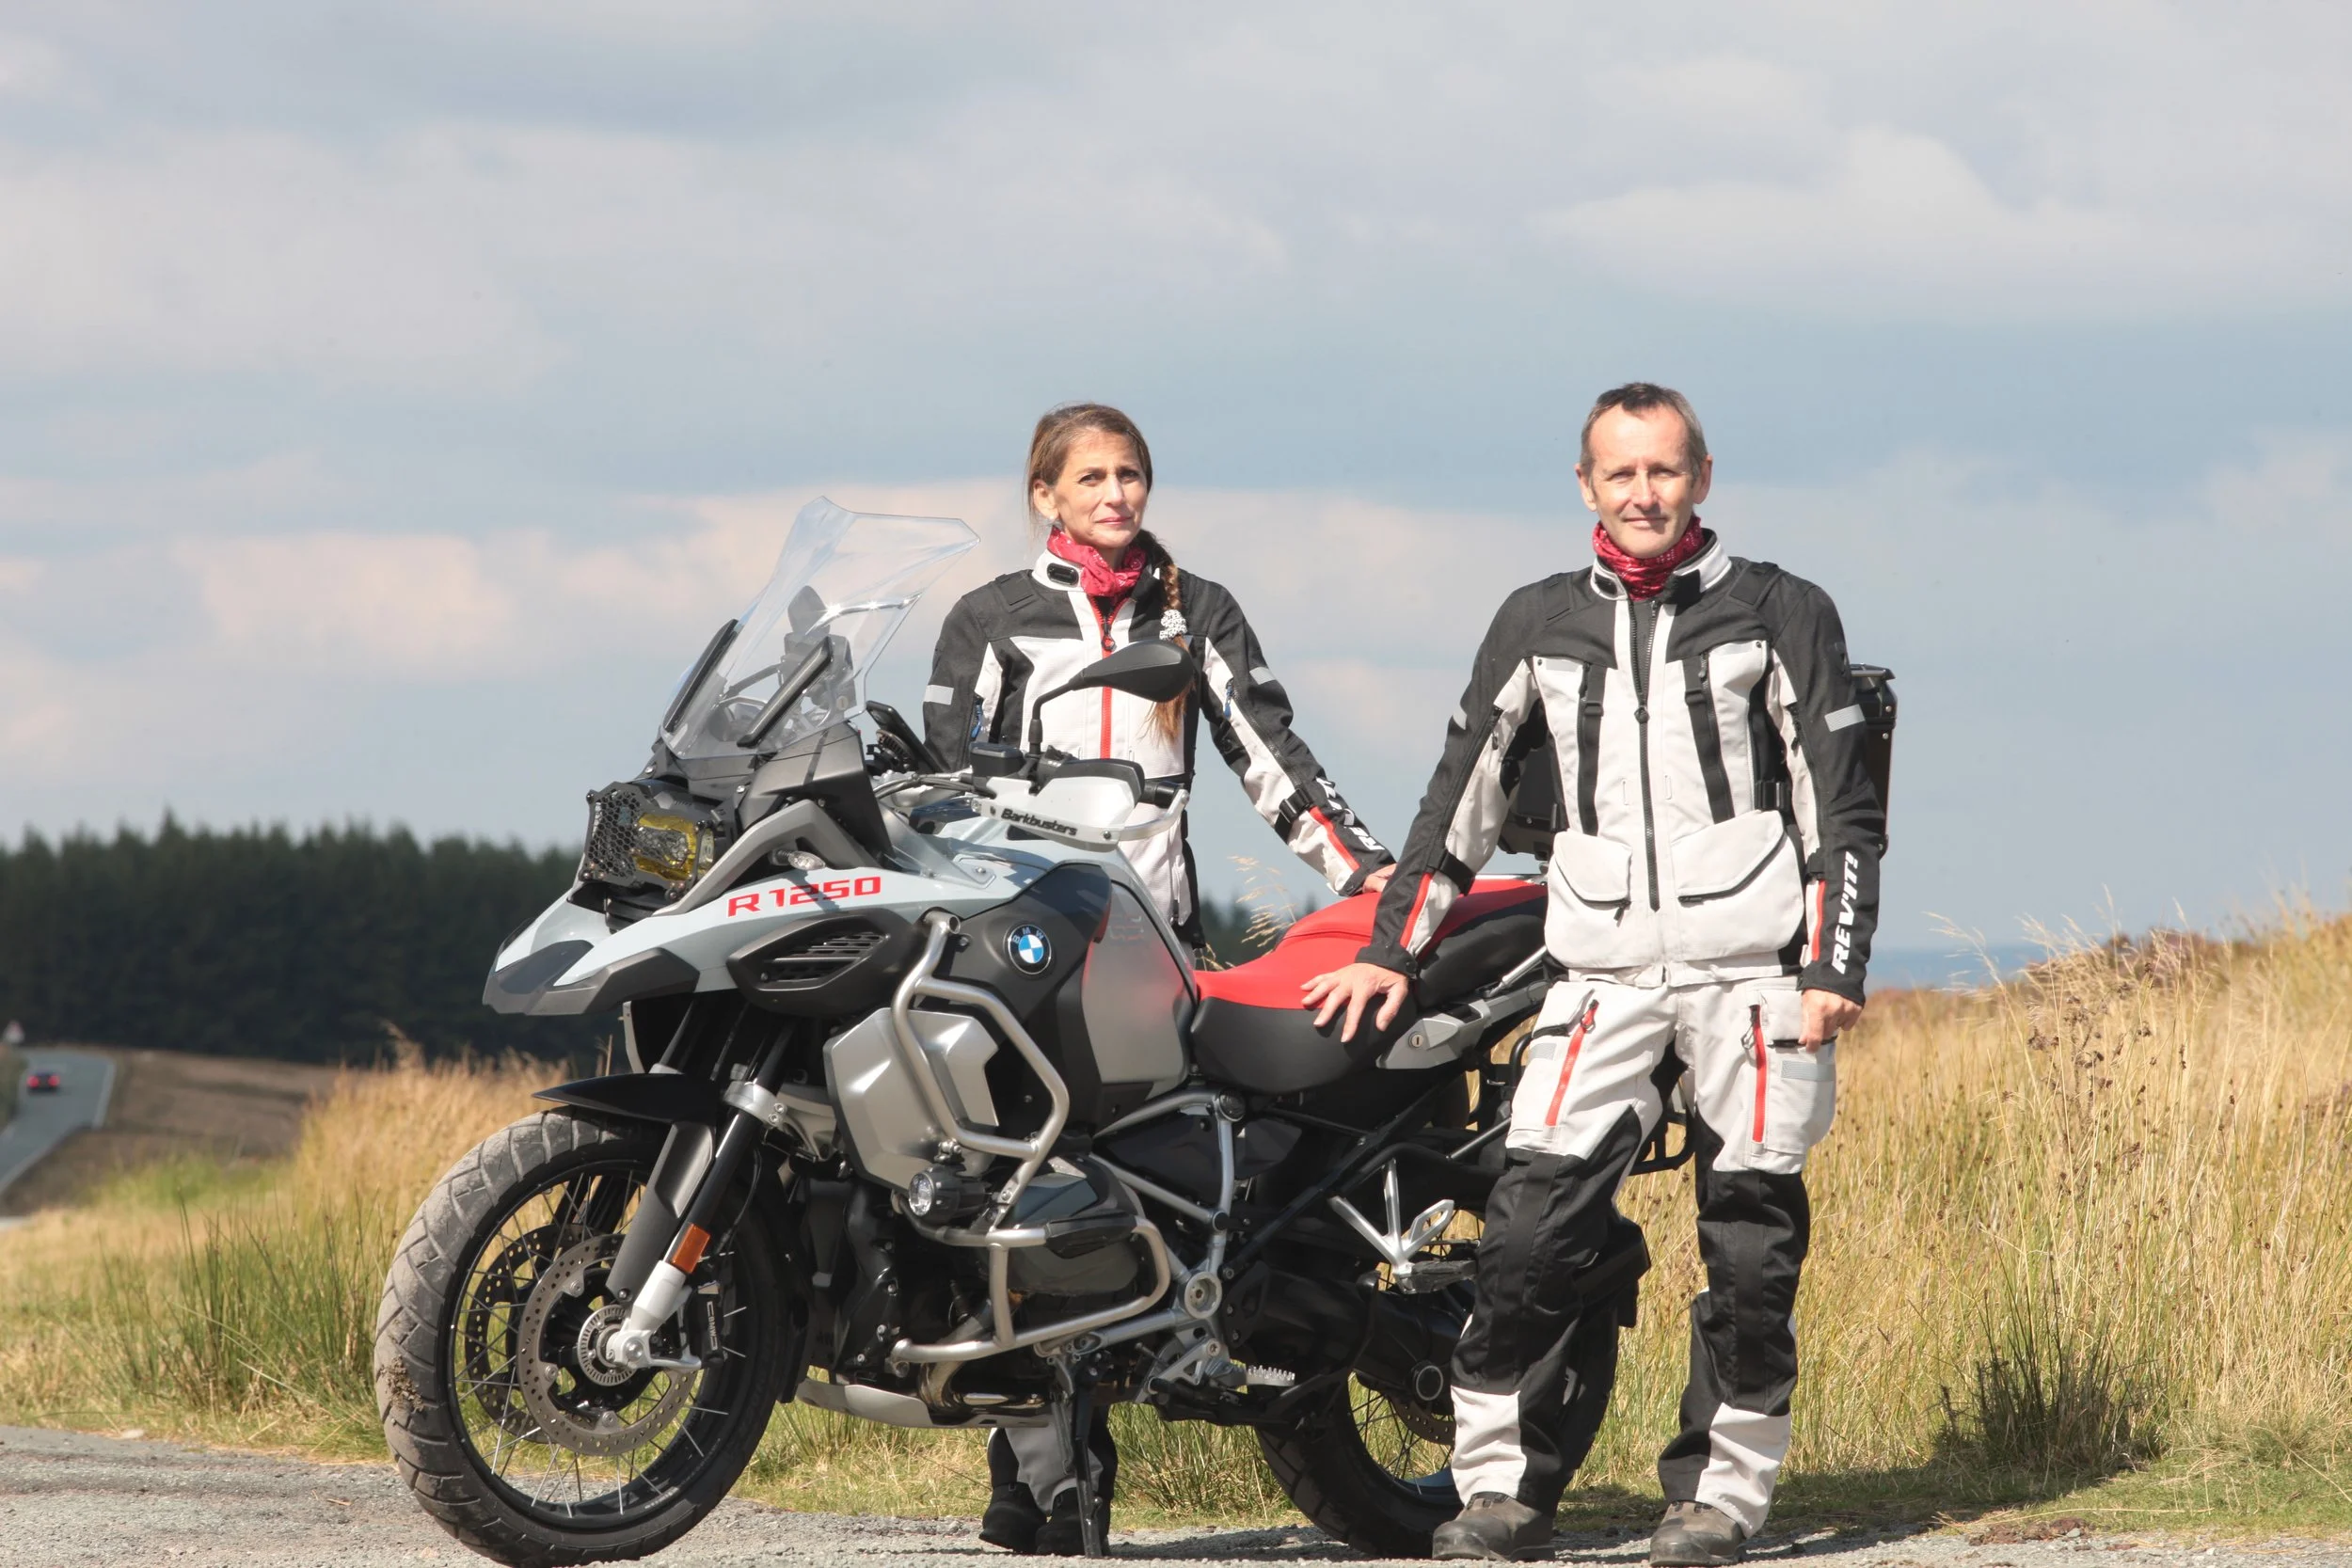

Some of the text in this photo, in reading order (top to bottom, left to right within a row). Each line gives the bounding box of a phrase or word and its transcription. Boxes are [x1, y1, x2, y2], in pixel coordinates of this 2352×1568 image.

[1001, 808, 1078, 836] Barkbusters
[727, 876, 882, 918] R 1250
[1831, 850, 1859, 975] REV'IT!
[1012, 927, 1045, 944] BMW
[707, 1316, 717, 1337] BMW
